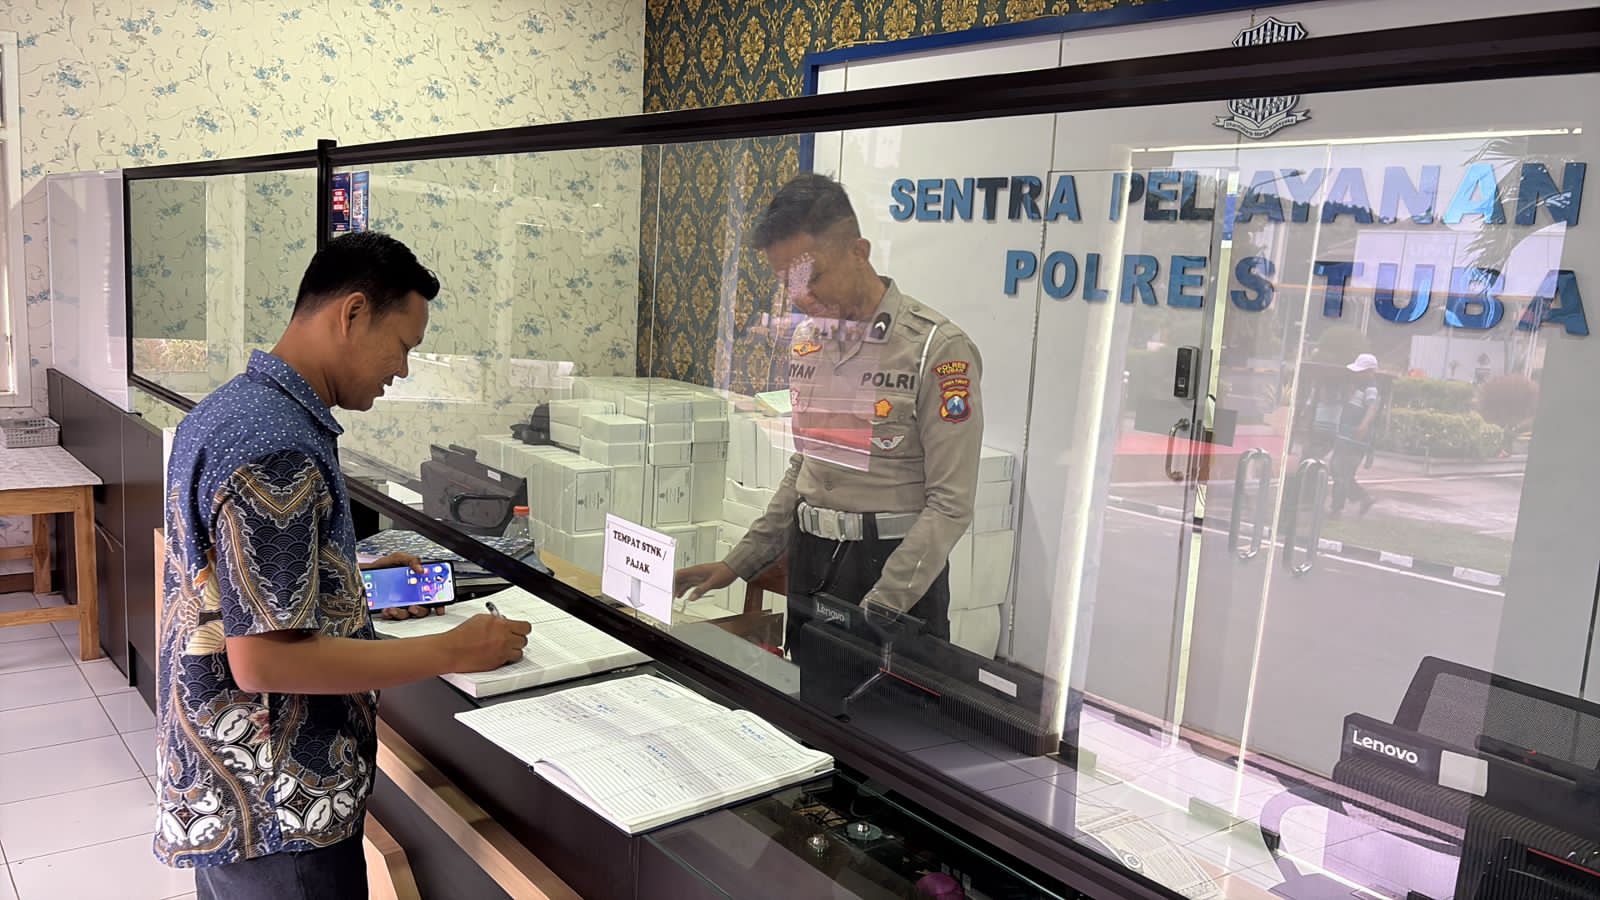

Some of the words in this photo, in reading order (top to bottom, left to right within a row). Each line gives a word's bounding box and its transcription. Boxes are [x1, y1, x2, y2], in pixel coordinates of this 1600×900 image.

[889, 175, 1082, 222] SENTRA
[1004, 250, 1276, 312] POLRES
[1313, 260, 1590, 335] TUBA
[861, 372, 915, 390] POLRI
[613, 530, 641, 549] TEMPAT
[641, 541, 662, 558] STNK
[625, 556, 650, 574] PAJAK
[816, 601, 845, 622] Lenovo
[1352, 729, 1418, 764] Lenovo
